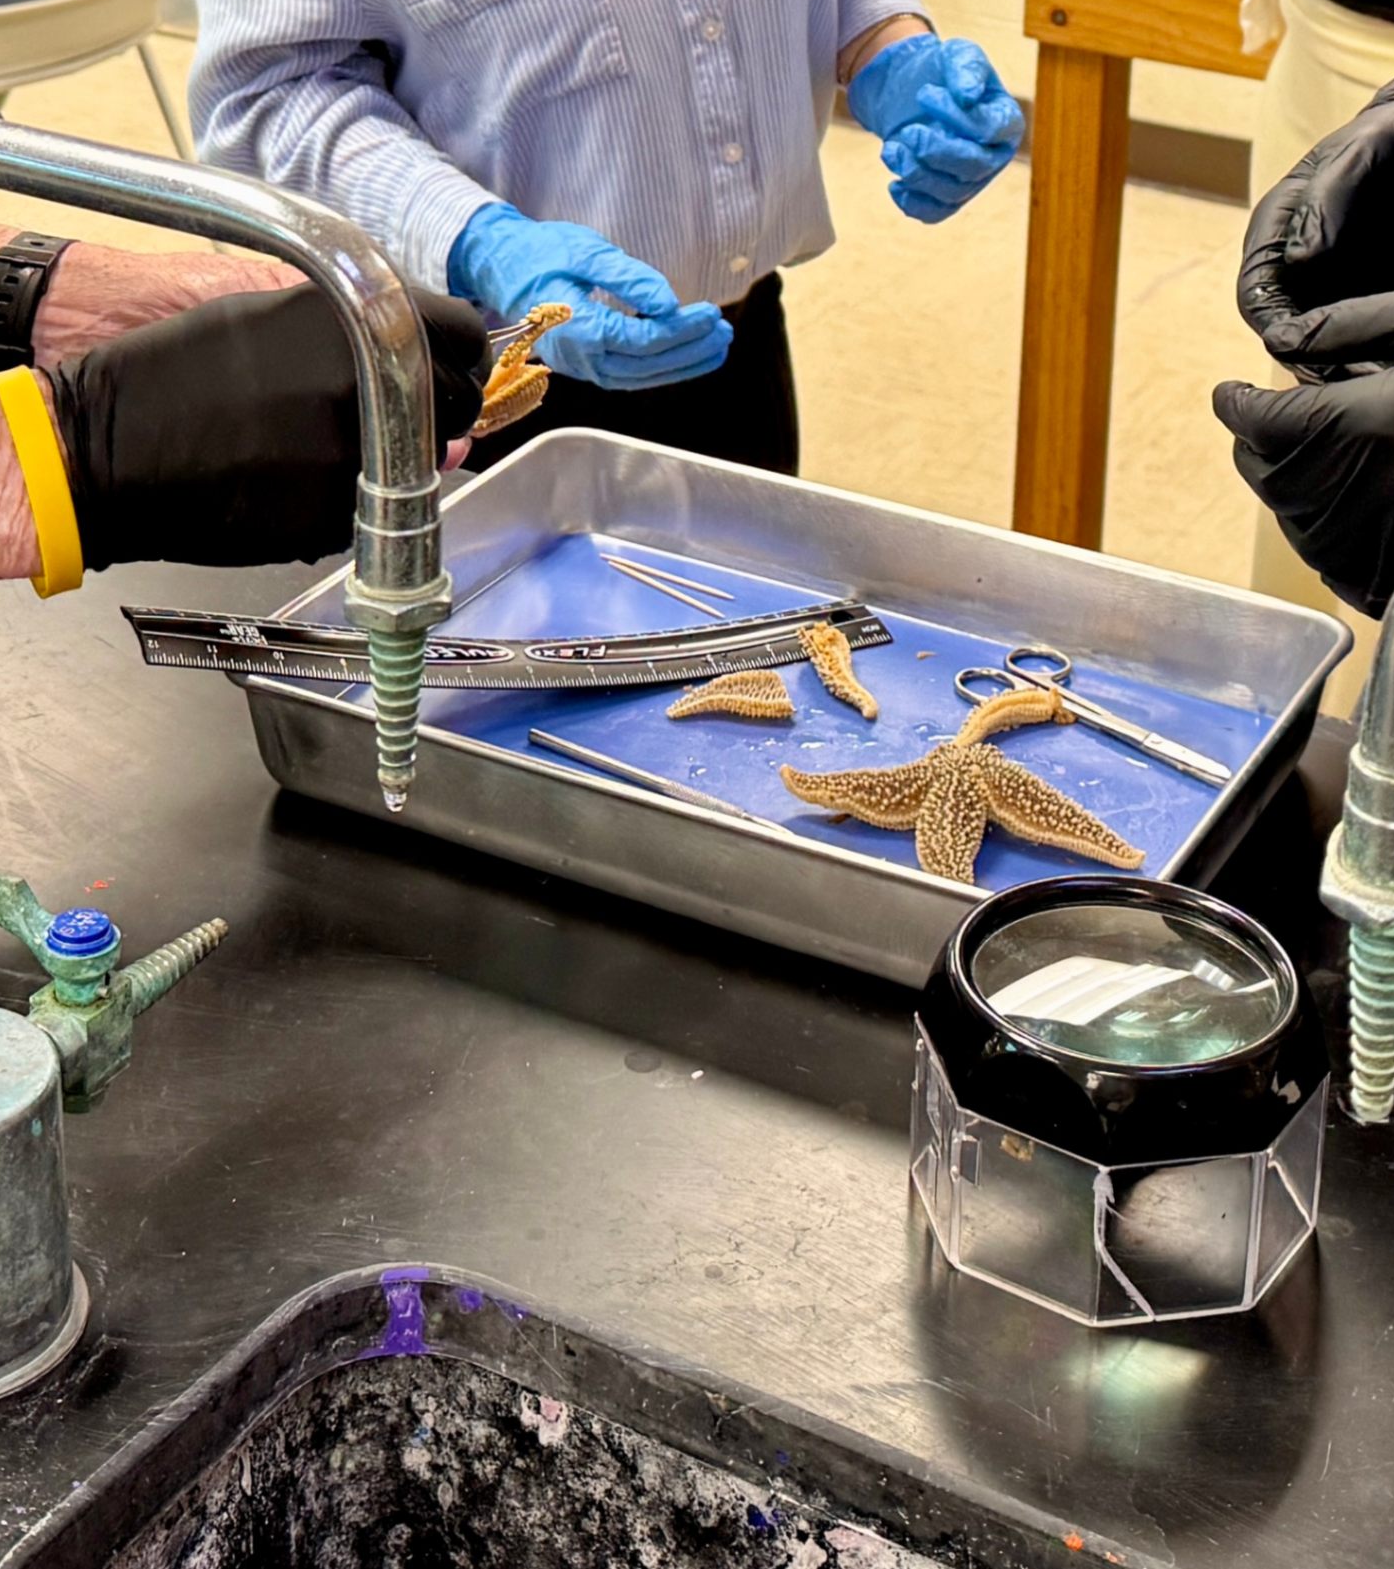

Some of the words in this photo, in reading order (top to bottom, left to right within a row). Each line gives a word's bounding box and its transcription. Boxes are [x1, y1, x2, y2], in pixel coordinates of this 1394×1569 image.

[147, 638, 160, 649] 12
[206, 644, 219, 654] 11
[272, 651, 286, 661] 10
